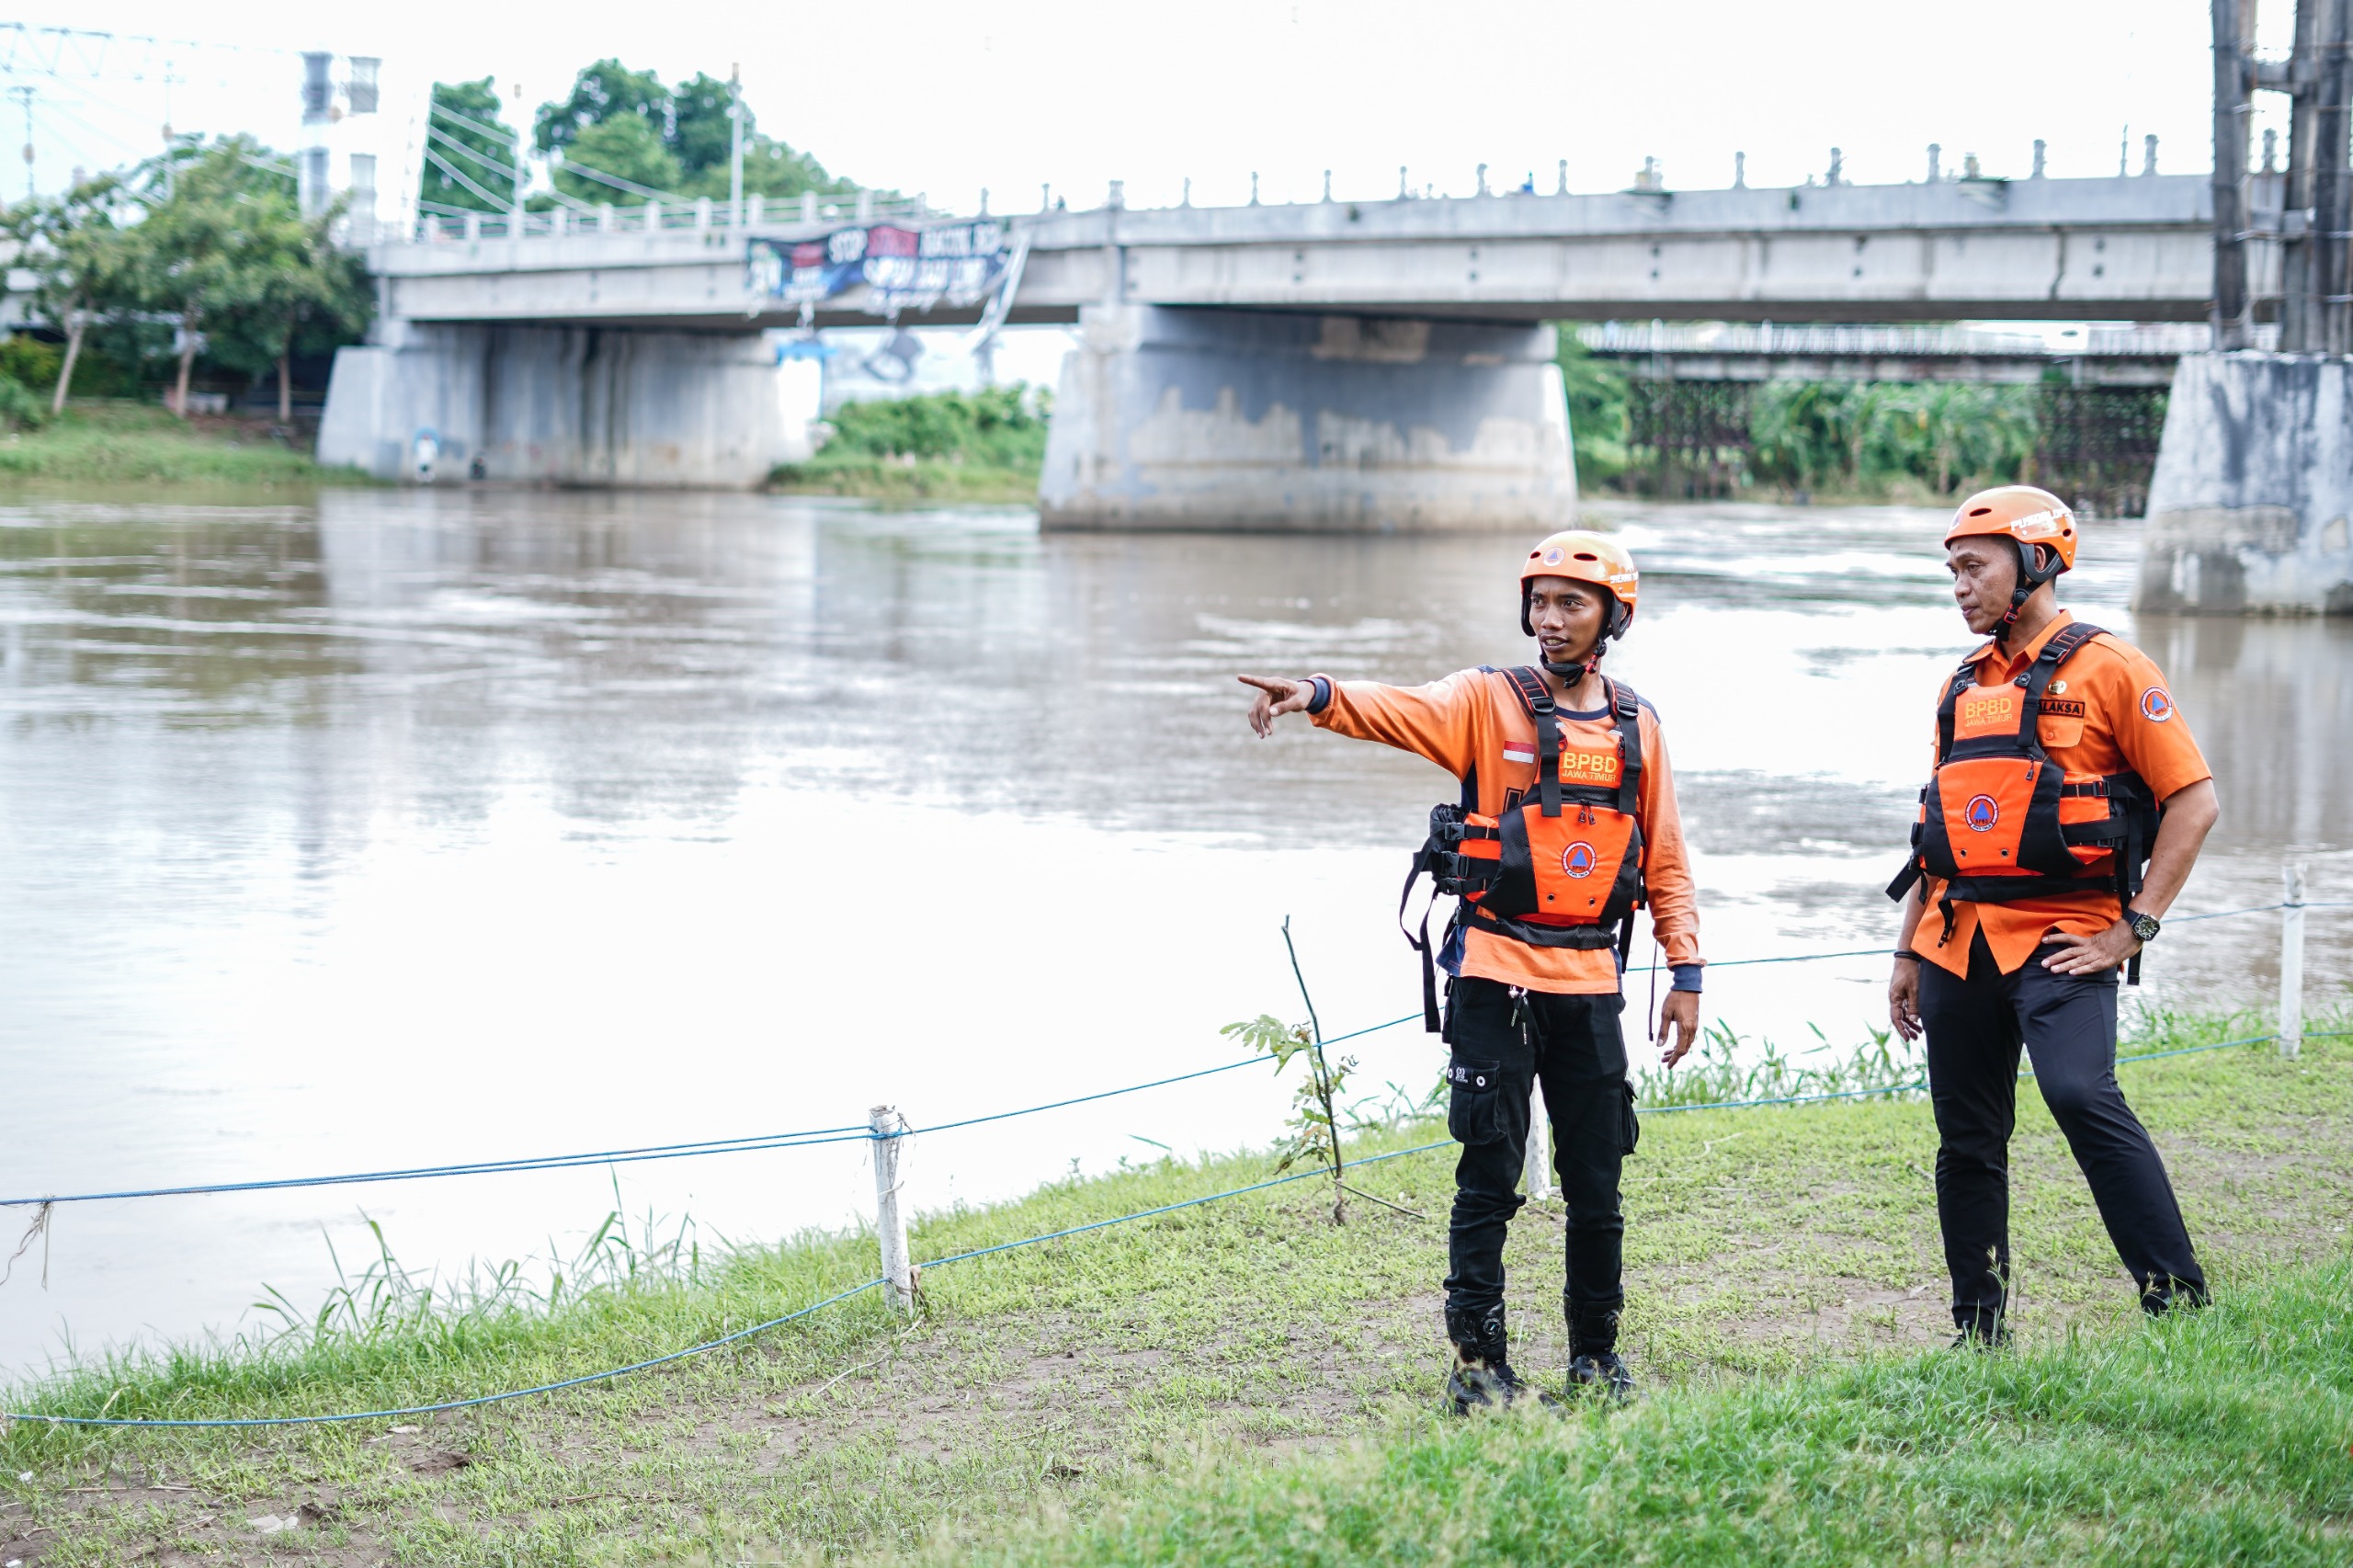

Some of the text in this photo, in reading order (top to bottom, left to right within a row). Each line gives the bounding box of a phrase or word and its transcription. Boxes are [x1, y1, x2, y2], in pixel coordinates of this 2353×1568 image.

[1965, 698, 2012, 719] BPBD
[1965, 713, 2013, 727] JAWA TIMUR
[1563, 752, 1618, 774] BPBD
[1562, 769, 1616, 782] JAWA TIMUR
